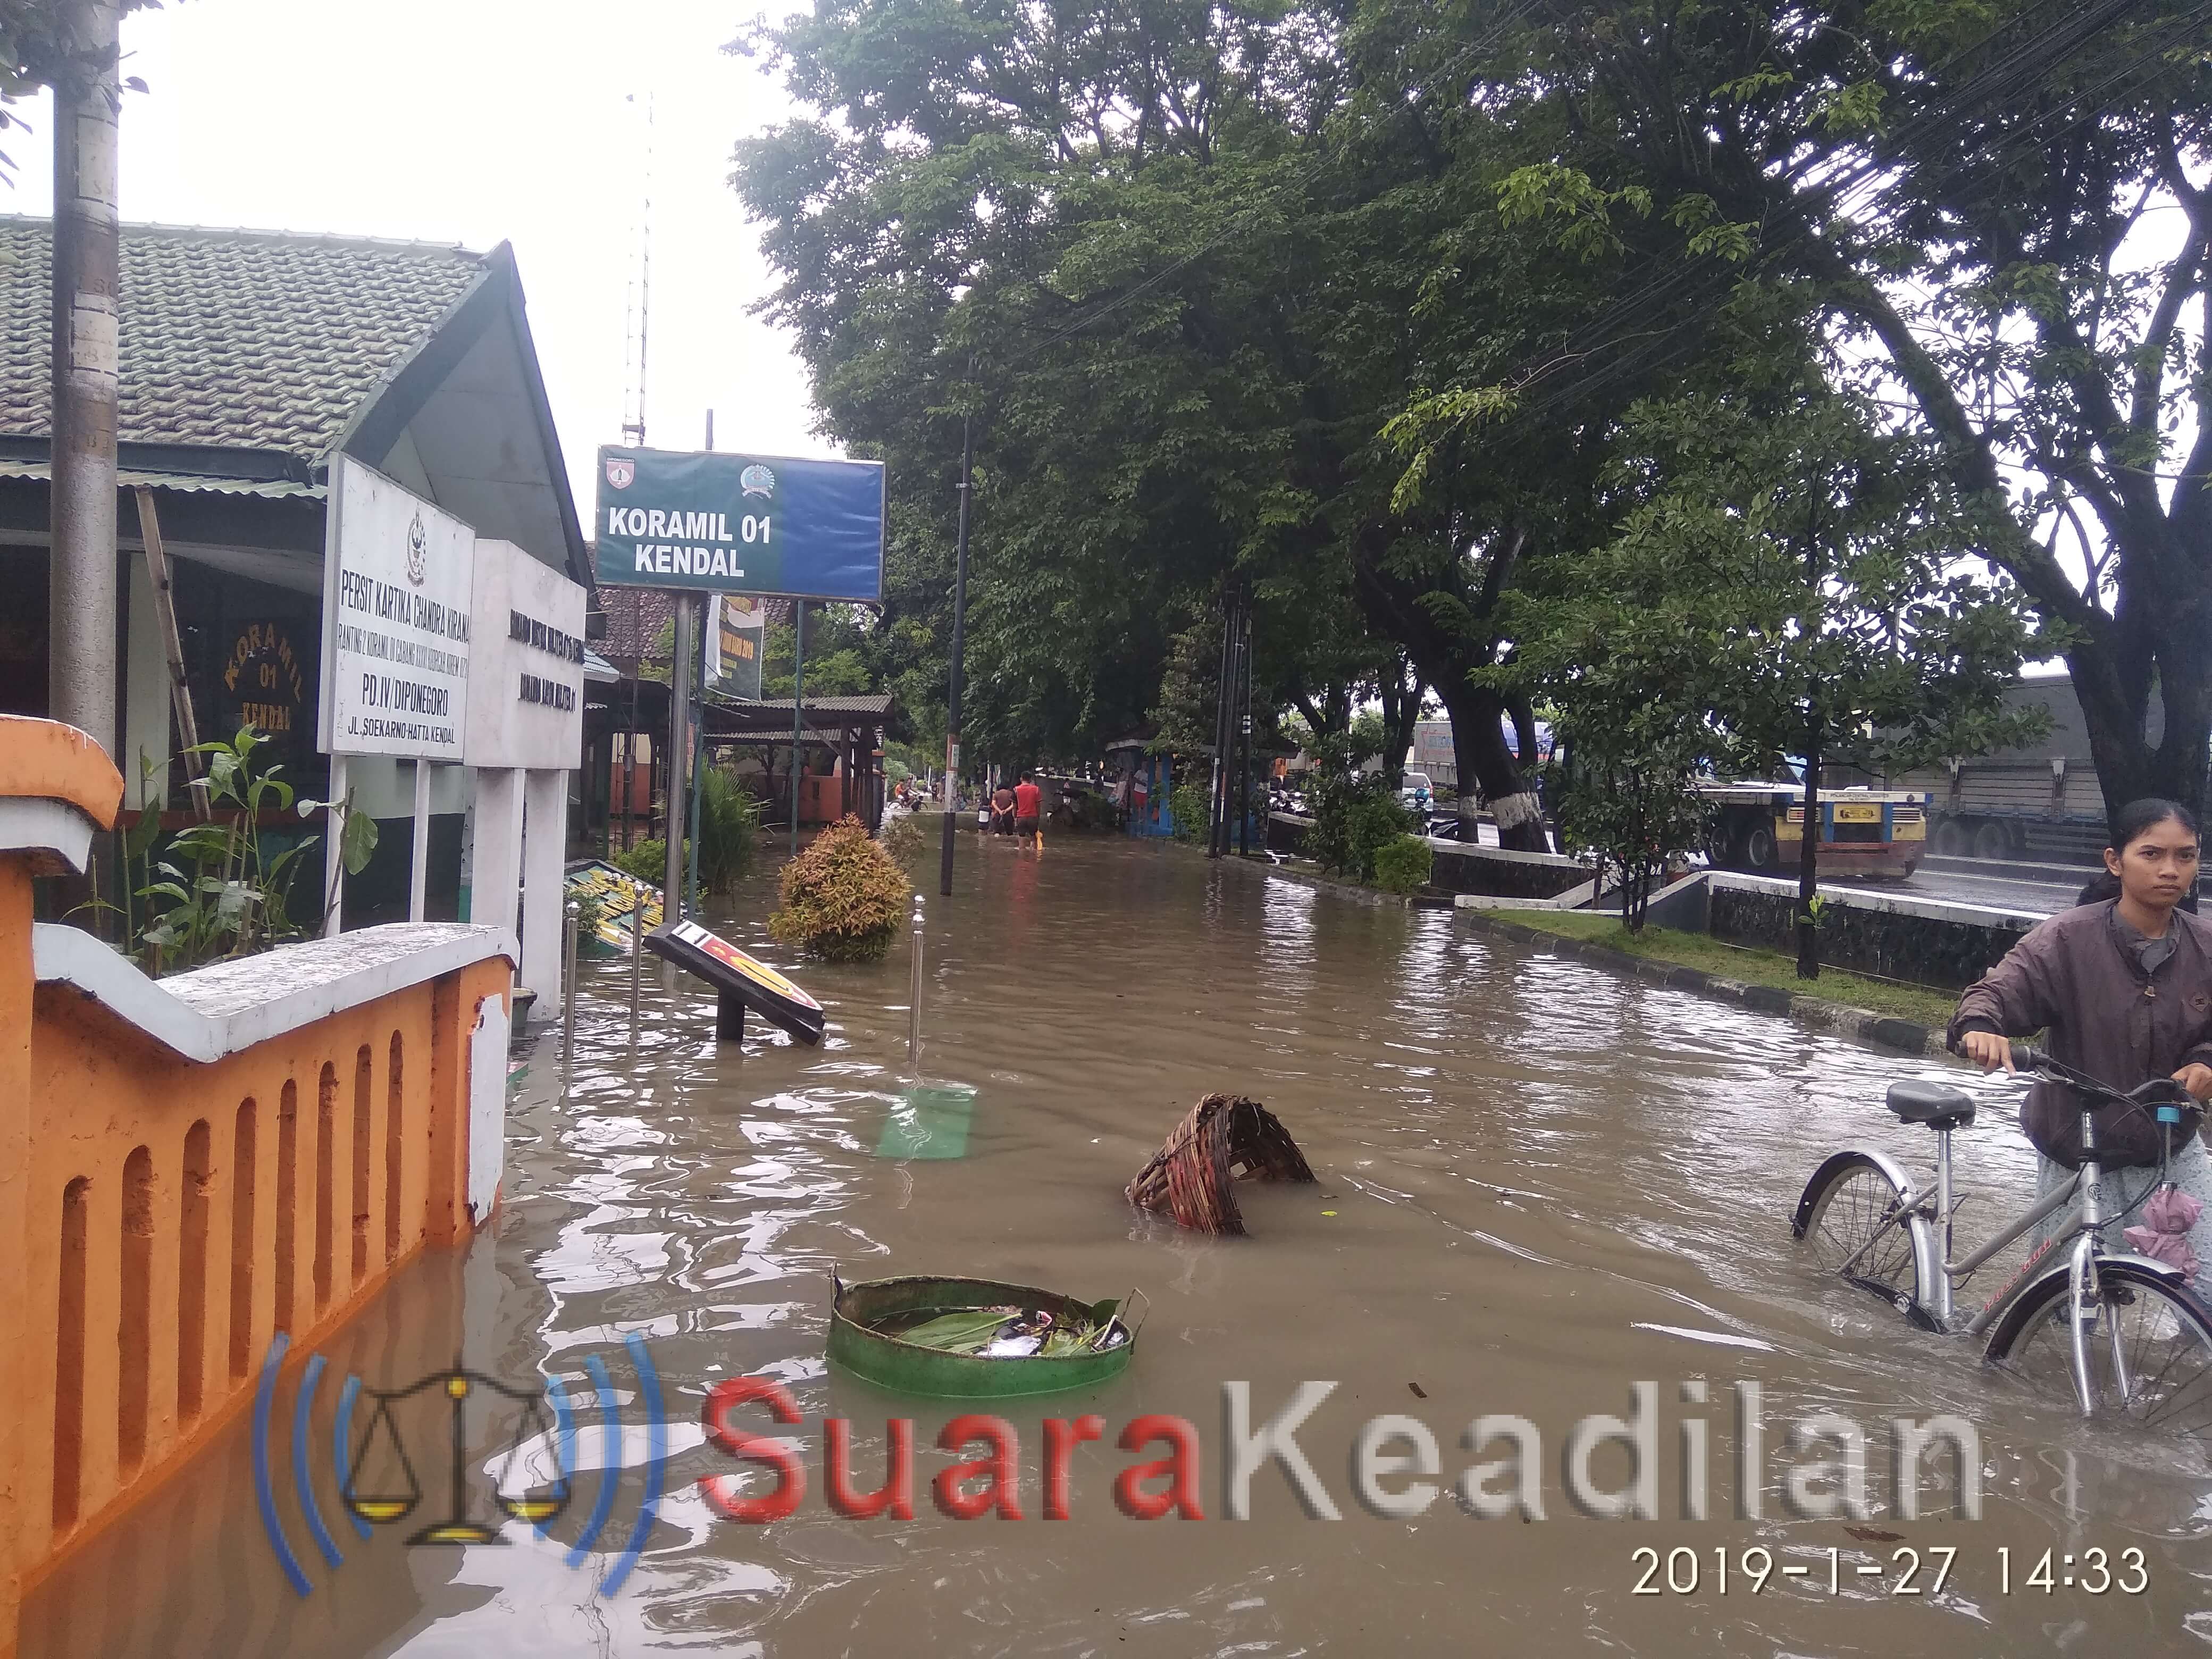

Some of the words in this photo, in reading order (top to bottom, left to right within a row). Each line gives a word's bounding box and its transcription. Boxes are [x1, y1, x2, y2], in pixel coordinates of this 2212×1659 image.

[609, 507, 733, 541] KORAMIL
[742, 516, 770, 543] 01
[635, 544, 744, 577] KENDAL
[341, 568, 373, 614] PERSIT
[375, 581, 410, 625] KARTIKA
[414, 594, 445, 636] CHANDRA
[447, 607, 469, 644] KIRANA
[338, 623, 362, 654] RANTING
[362, 630, 366, 655] 2
[367, 631, 389, 660] KORAMIL
[396, 639, 415, 666] CABANG
[260, 663, 276, 689] 01
[362, 673, 448, 716] PD.IV/DIPONEGORO
[242, 702, 290, 730] KENDAL
[431, 726, 455, 744] KENDAL
